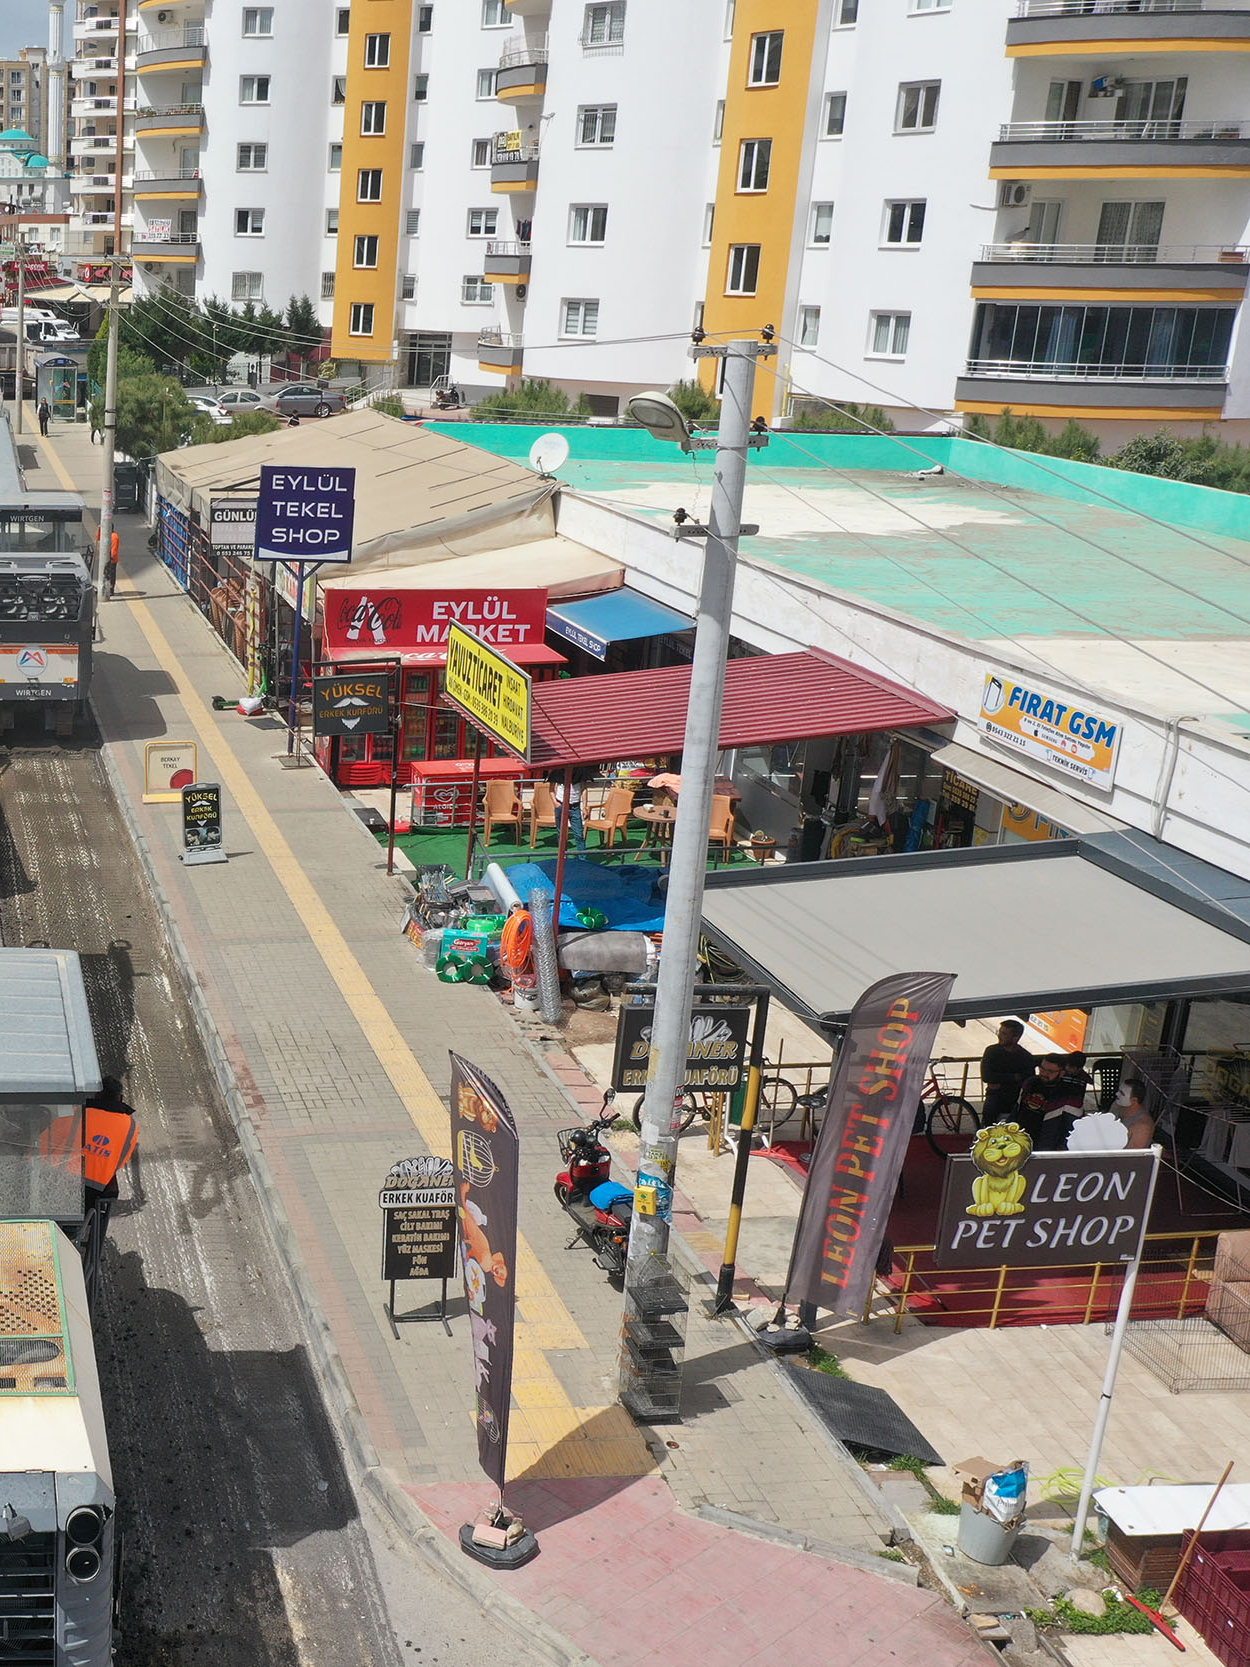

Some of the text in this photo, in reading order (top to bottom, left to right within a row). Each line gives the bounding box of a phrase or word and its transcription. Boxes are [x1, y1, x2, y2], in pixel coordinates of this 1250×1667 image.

[272, 474, 347, 492] EYLÜL
[214, 509, 257, 522] GÜNLÜ
[272, 501, 343, 518] TEKEL
[271, 528, 340, 544] SHOP
[432, 596, 517, 619] EYLÜL
[416, 624, 531, 643] MARKET
[449, 638, 503, 710] YAVUZ TİCARET
[15, 689, 52, 697] WIRTGEN
[320, 682, 383, 701] YÜKSEL
[319, 709, 345, 718] ERKEK
[1008, 686, 1118, 749] FIRAT GSM
[1052, 753, 1088, 776] TEKNİK SERVİS
[185, 792, 218, 803] YÜKSEL
[820, 996, 921, 1290] LEON PET SHOP
[1030, 1171, 1137, 1203] LEON
[383, 1190, 454, 1204] ERKEK KUAFÖR
[408, 1210, 430, 1219] SAKAL
[400, 1221, 415, 1231] CİLT
[950, 1215, 1135, 1249] PET SHOP
[397, 1244, 411, 1254] YÜZ
